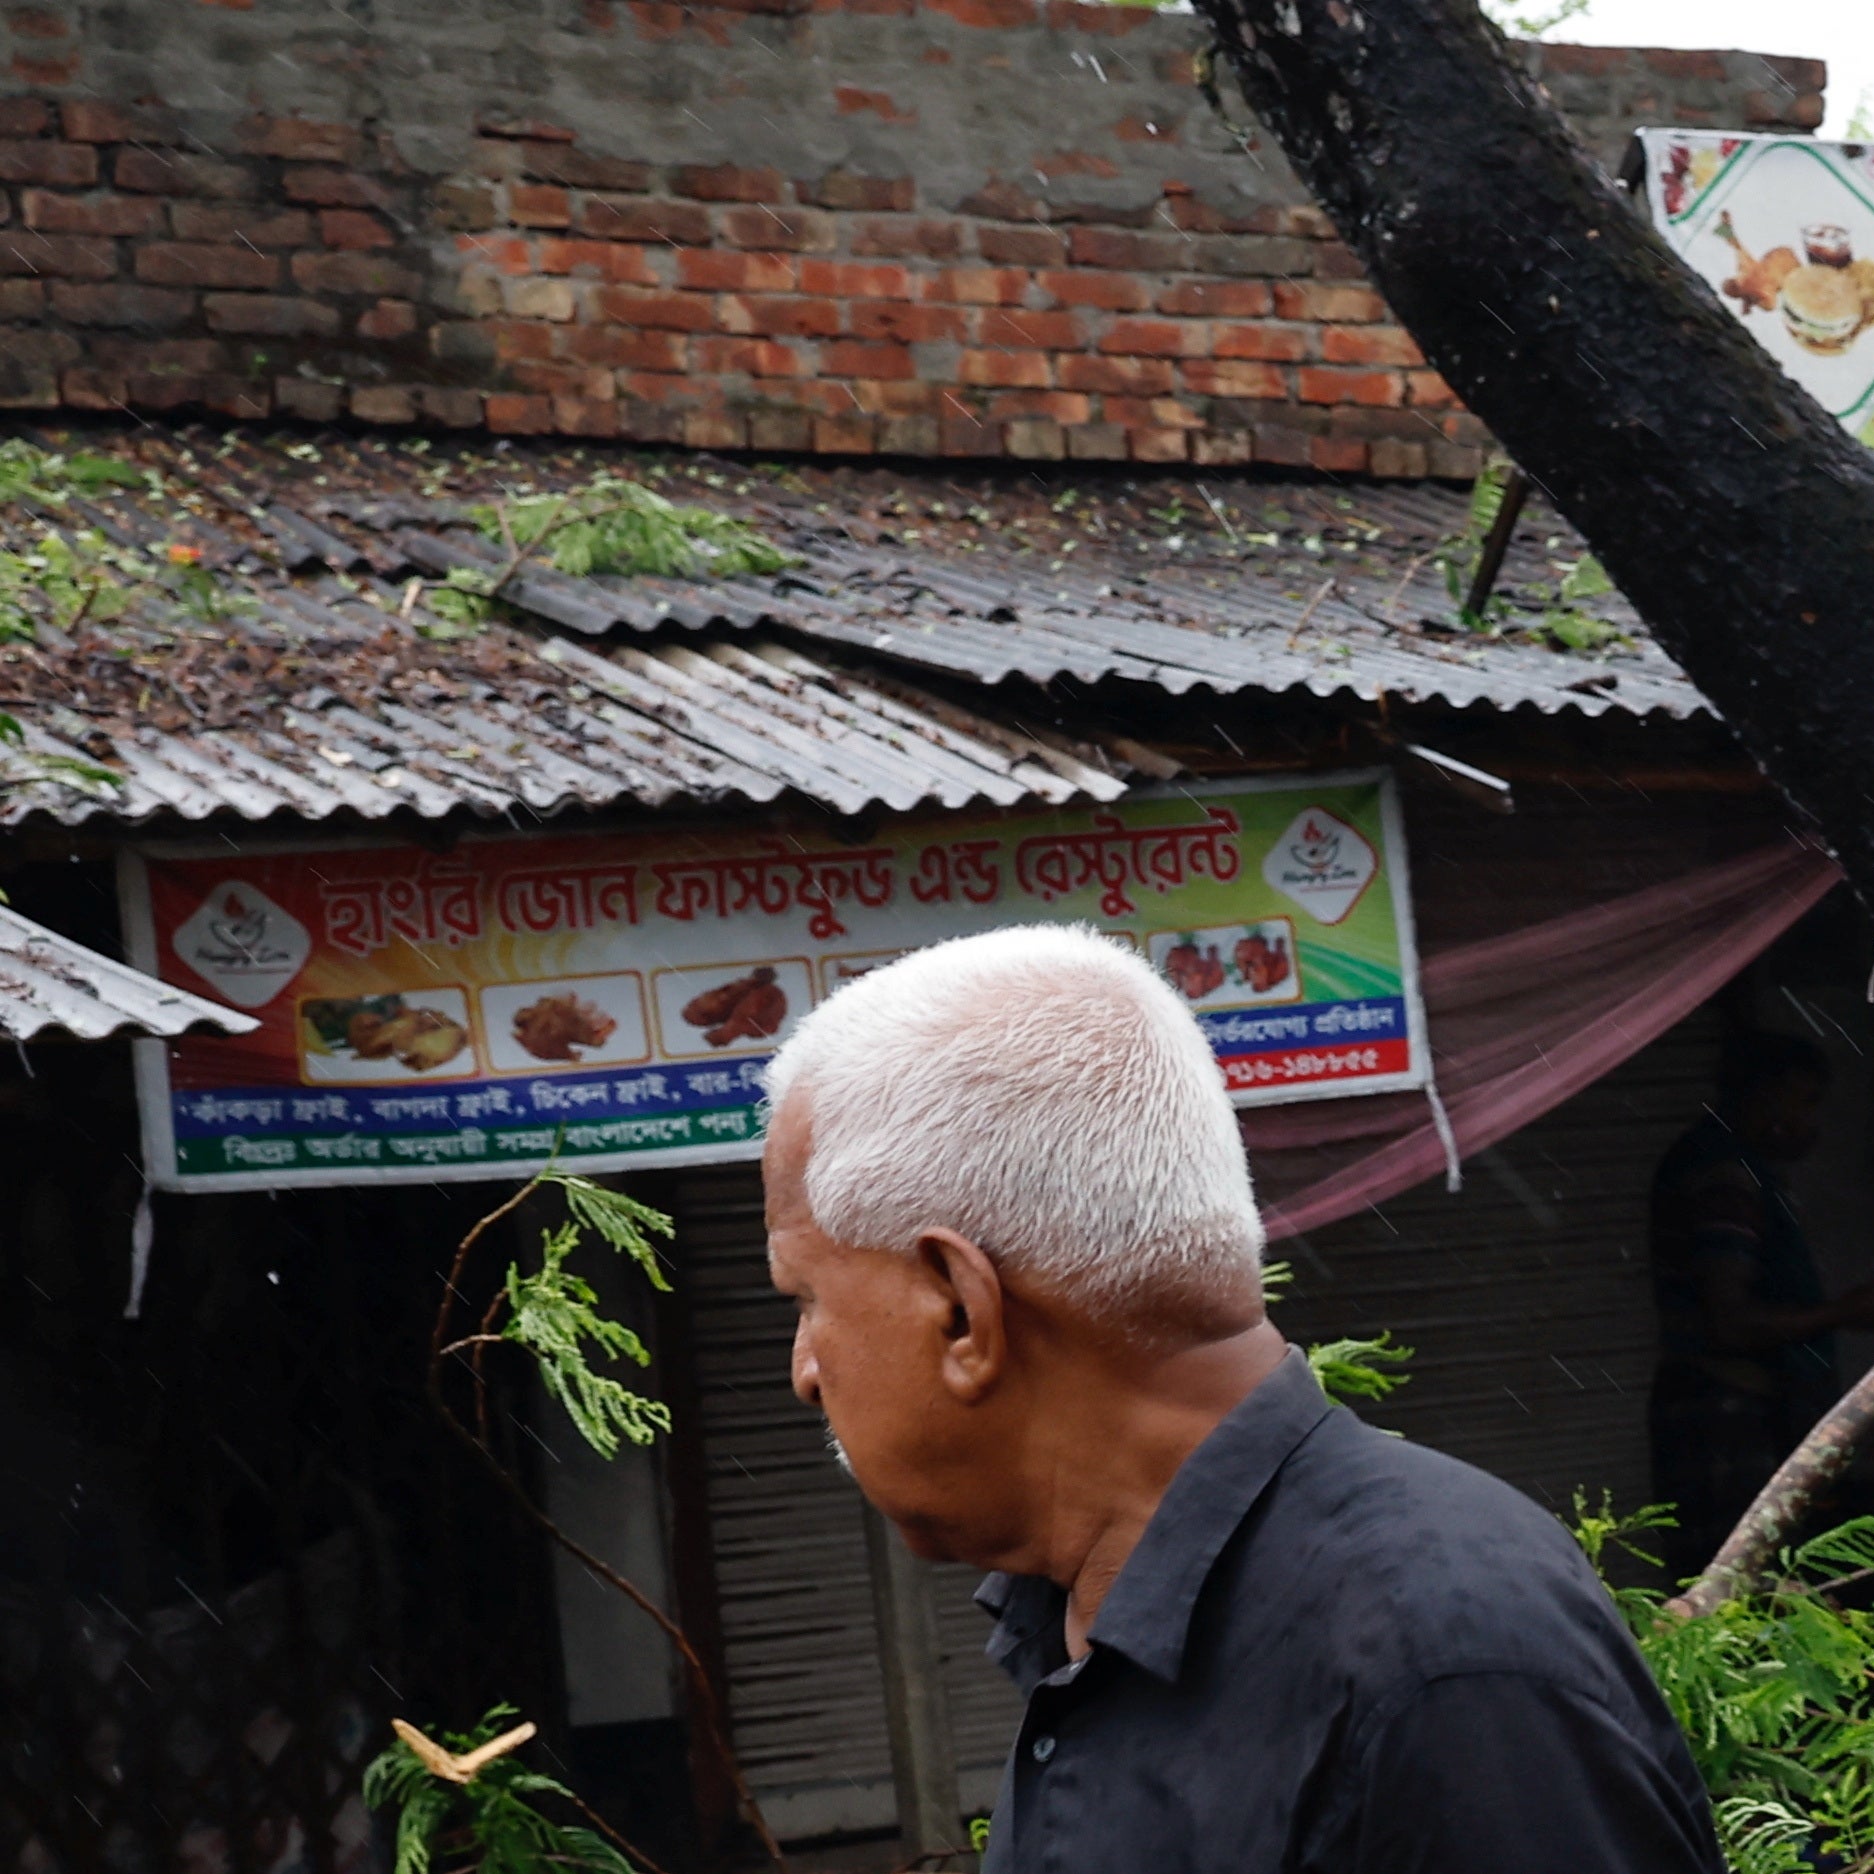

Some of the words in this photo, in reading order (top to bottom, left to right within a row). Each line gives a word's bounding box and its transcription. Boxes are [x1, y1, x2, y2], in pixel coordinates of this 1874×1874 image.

[320, 855, 482, 954] হাংরি
[500, 866, 639, 933] জোন
[652, 837, 894, 940] ফাস্টফুড
[909, 840, 1001, 904] এন্ড
[1014, 806, 1240, 918] রেস্টুরেন্ট
[1226, 1048, 1379, 1083] ৭১৬-১৪৮৮৫৫
